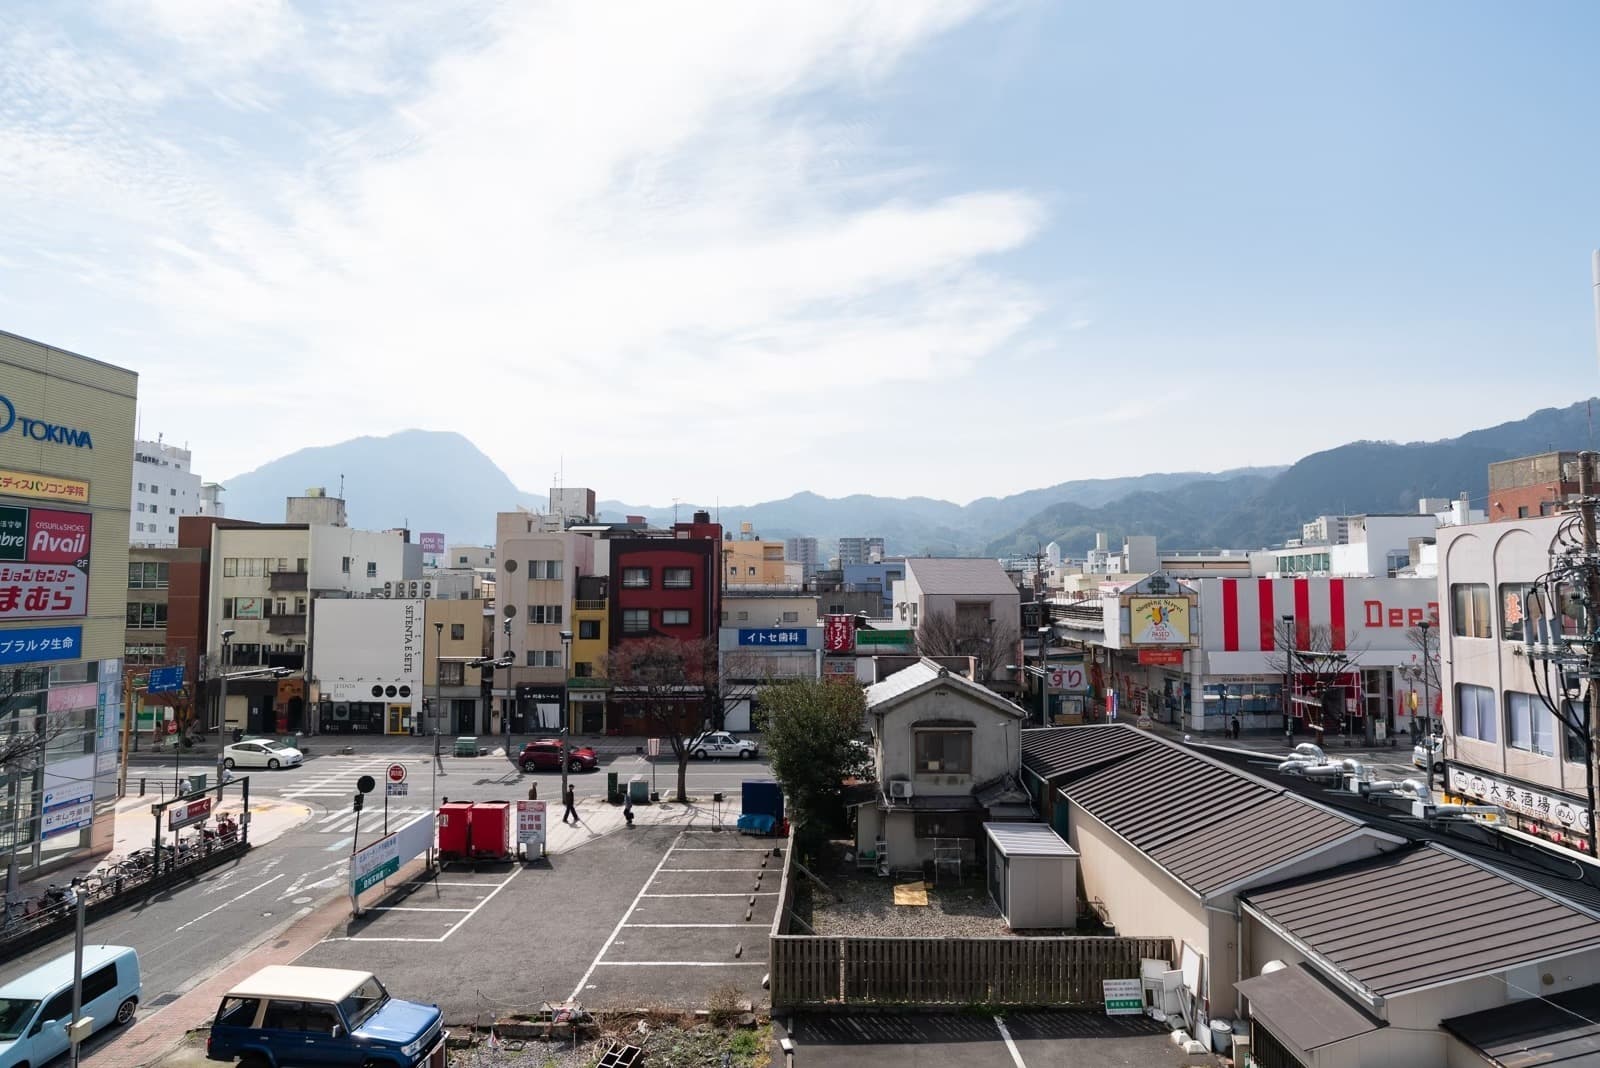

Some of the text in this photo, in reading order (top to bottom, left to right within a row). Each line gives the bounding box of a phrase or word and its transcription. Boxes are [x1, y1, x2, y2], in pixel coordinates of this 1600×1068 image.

[18, 417, 93, 450] TOKIWA
[32, 530, 86, 553] Avail
[77, 559, 88, 568] 2F
[0, 568, 76, 583] ションセンター
[0, 585, 75, 612] まむら
[404, 605, 414, 644] SETENTA
[834, 622, 843, 650] ラーメン
[747, 631, 799, 642] イトセ歯科
[403, 652, 413, 673] SETE
[1490, 781, 1551, 813] 大衆酒場
[1557, 808, 1574, 821] めん
